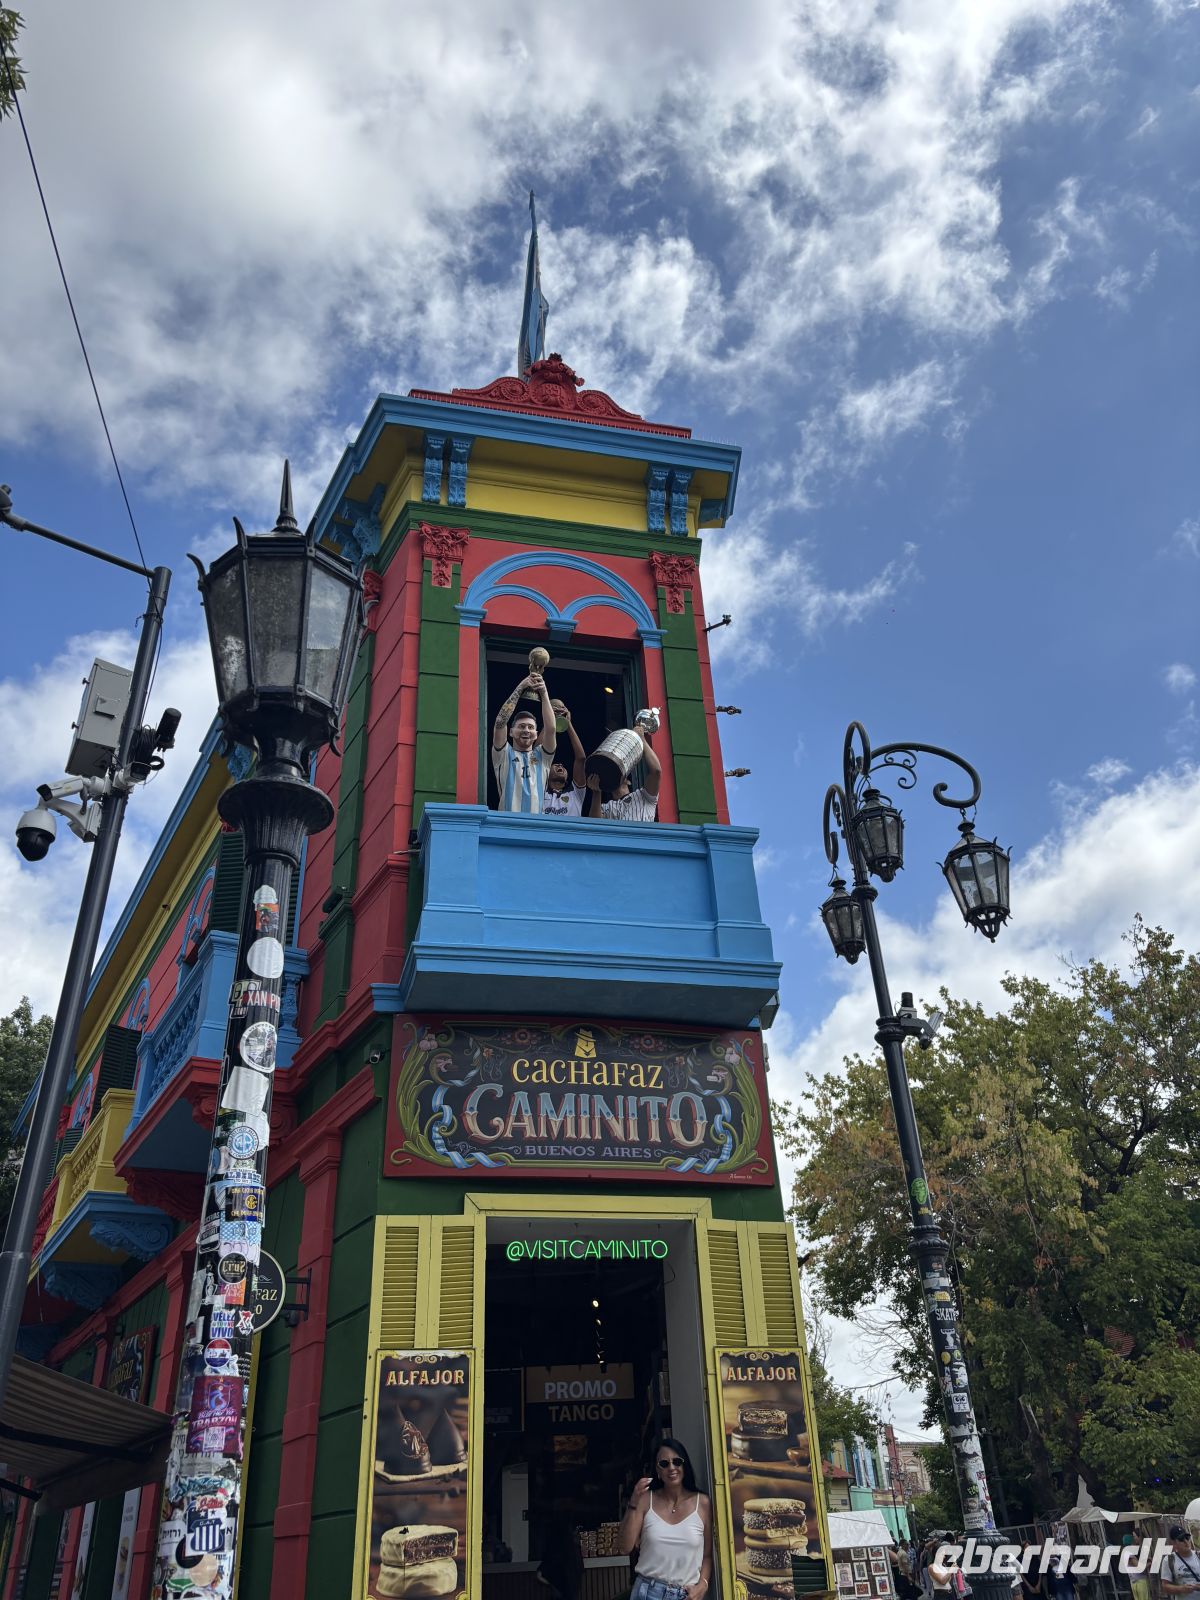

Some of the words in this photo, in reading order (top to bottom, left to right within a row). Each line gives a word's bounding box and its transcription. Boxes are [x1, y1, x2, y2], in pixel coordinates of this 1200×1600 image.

[461, 1083, 707, 1146] CAMINITO
[525, 1145, 596, 1157] BUENOS
[602, 1147, 652, 1158] AIRES
[506, 1239, 669, 1261] @VISITCAMINITO
[385, 1369, 465, 1386] ALFAJOR
[726, 1366, 797, 1381] ALFAJOR
[544, 1379, 617, 1400] PROMO
[548, 1403, 615, 1422] TANGO
